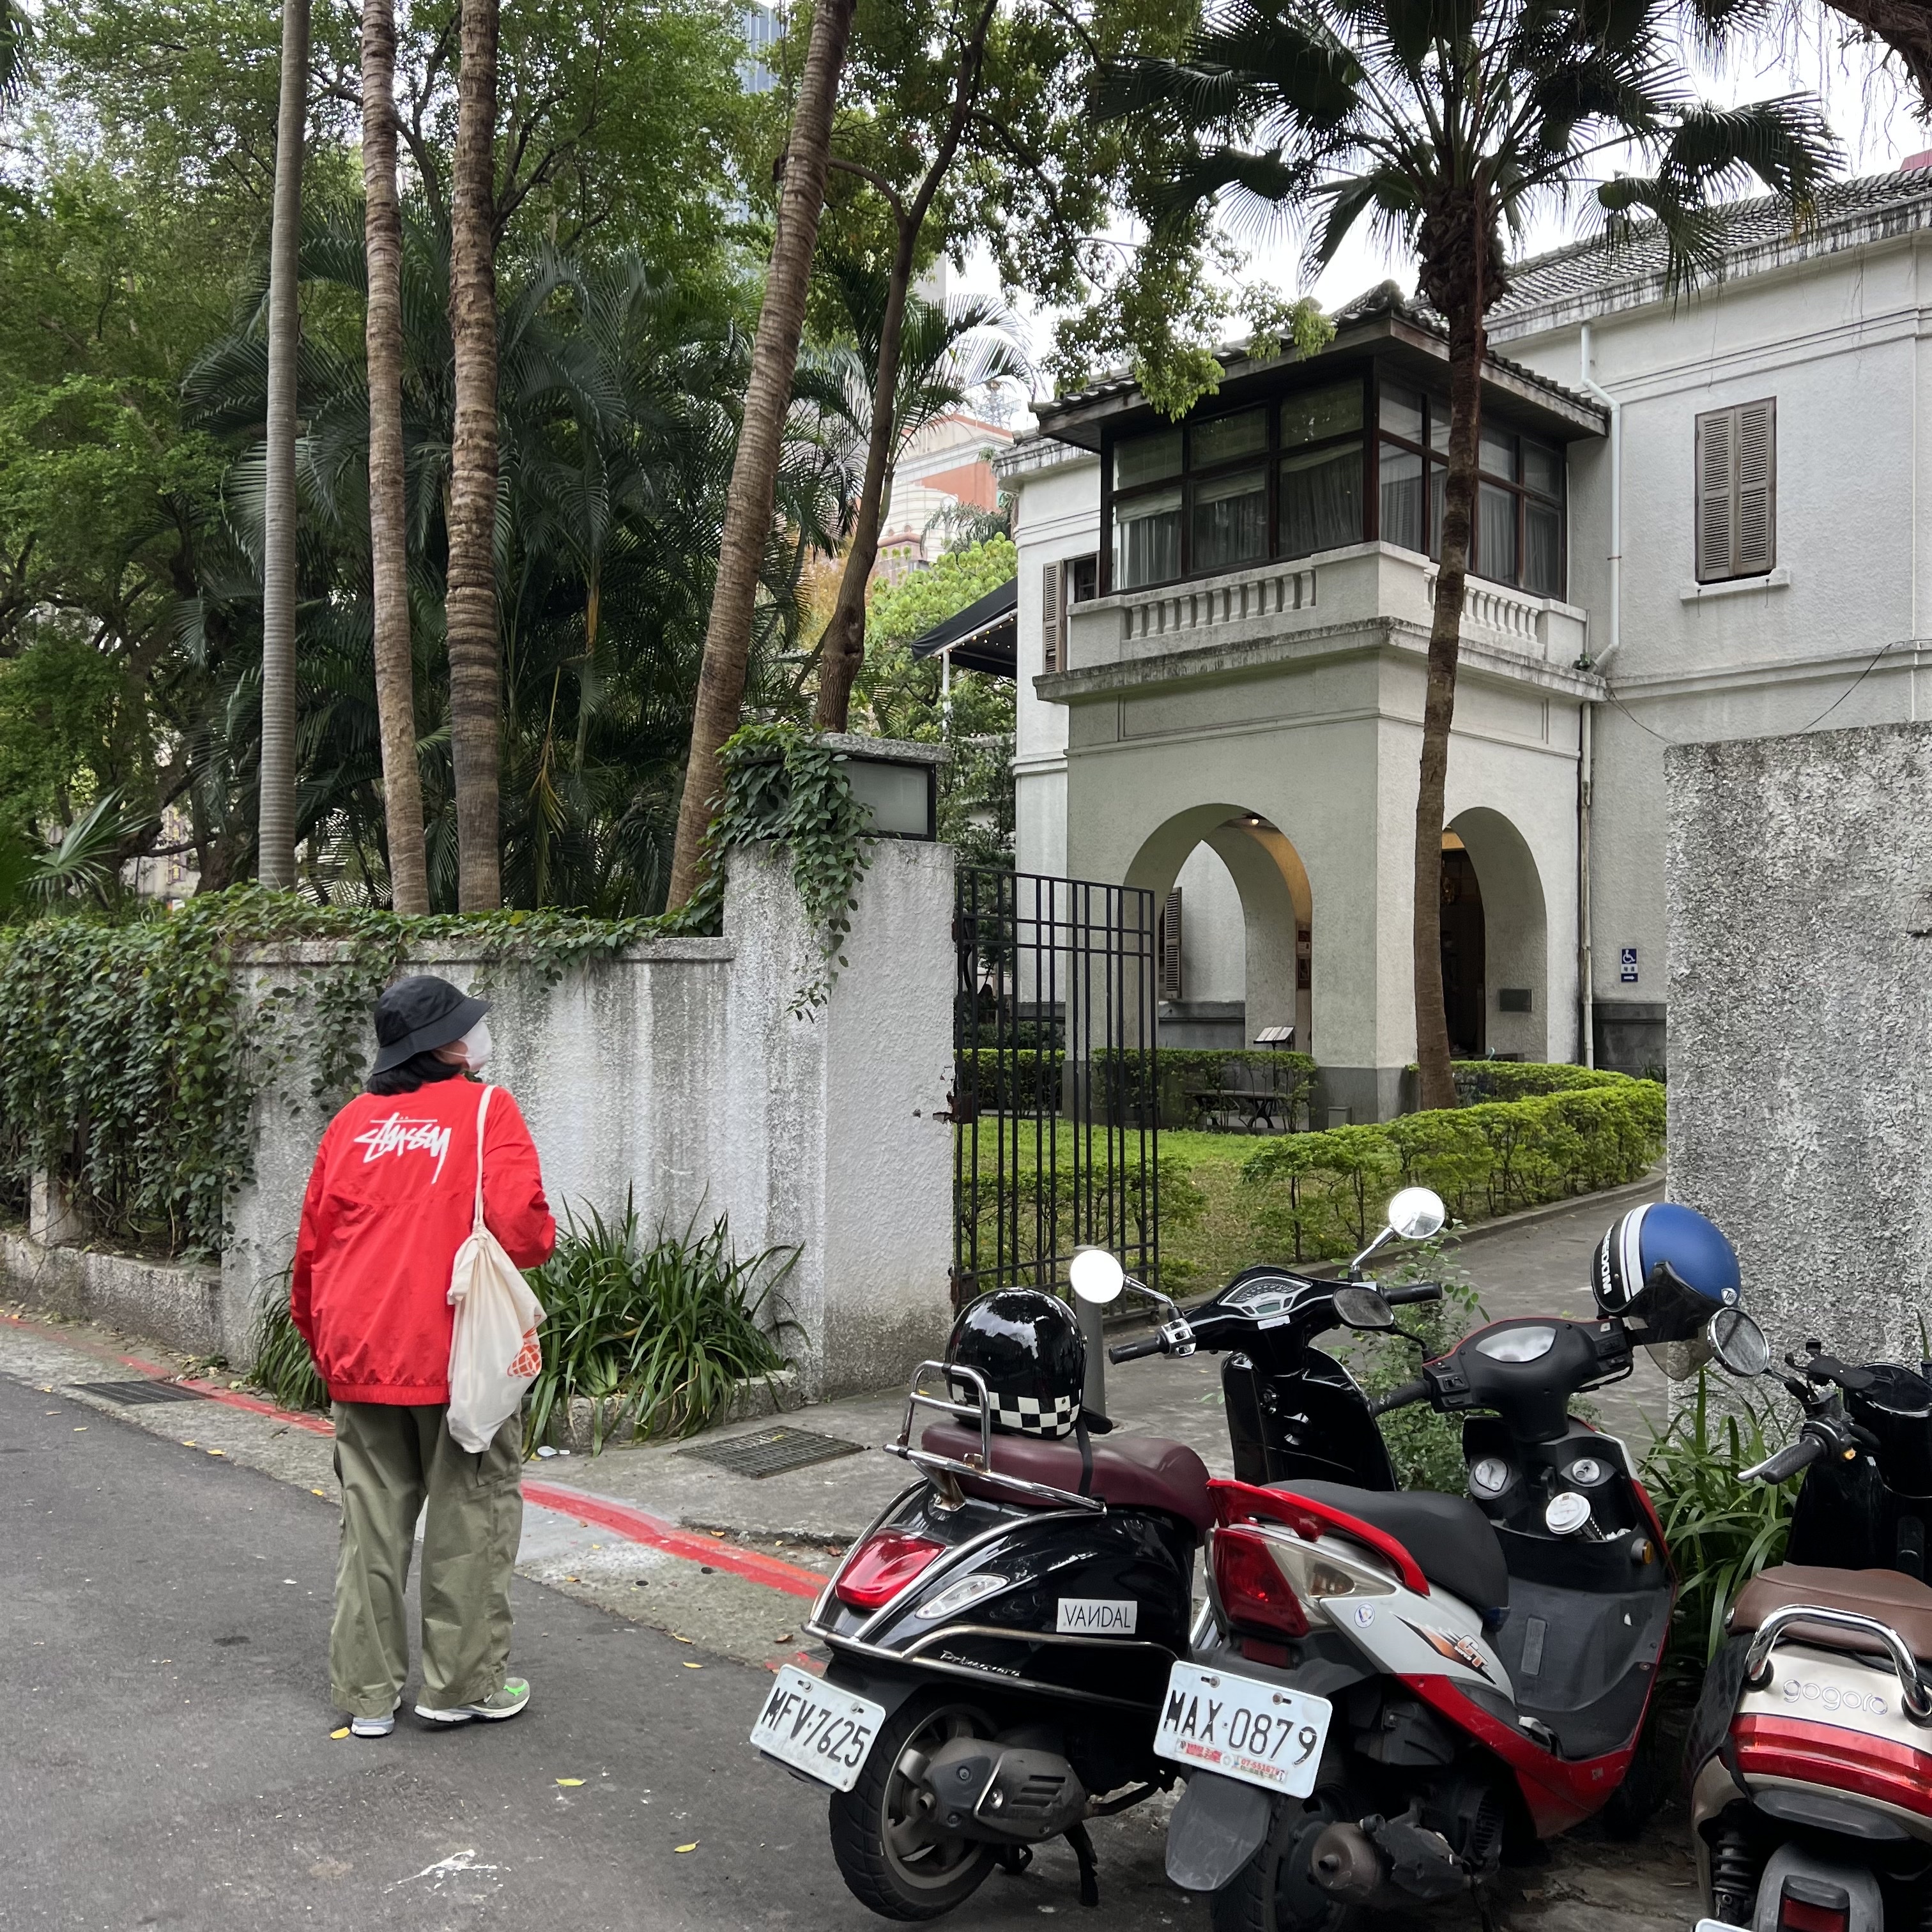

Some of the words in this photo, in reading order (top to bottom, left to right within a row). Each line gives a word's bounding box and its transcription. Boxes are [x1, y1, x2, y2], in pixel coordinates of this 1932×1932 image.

[1064, 1604, 1131, 1628] VANDAL
[1783, 1679, 1889, 1715] gogoro
[761, 1687, 871, 1768] MFV-7625
[1163, 1690, 1317, 1768] MAX-0879
